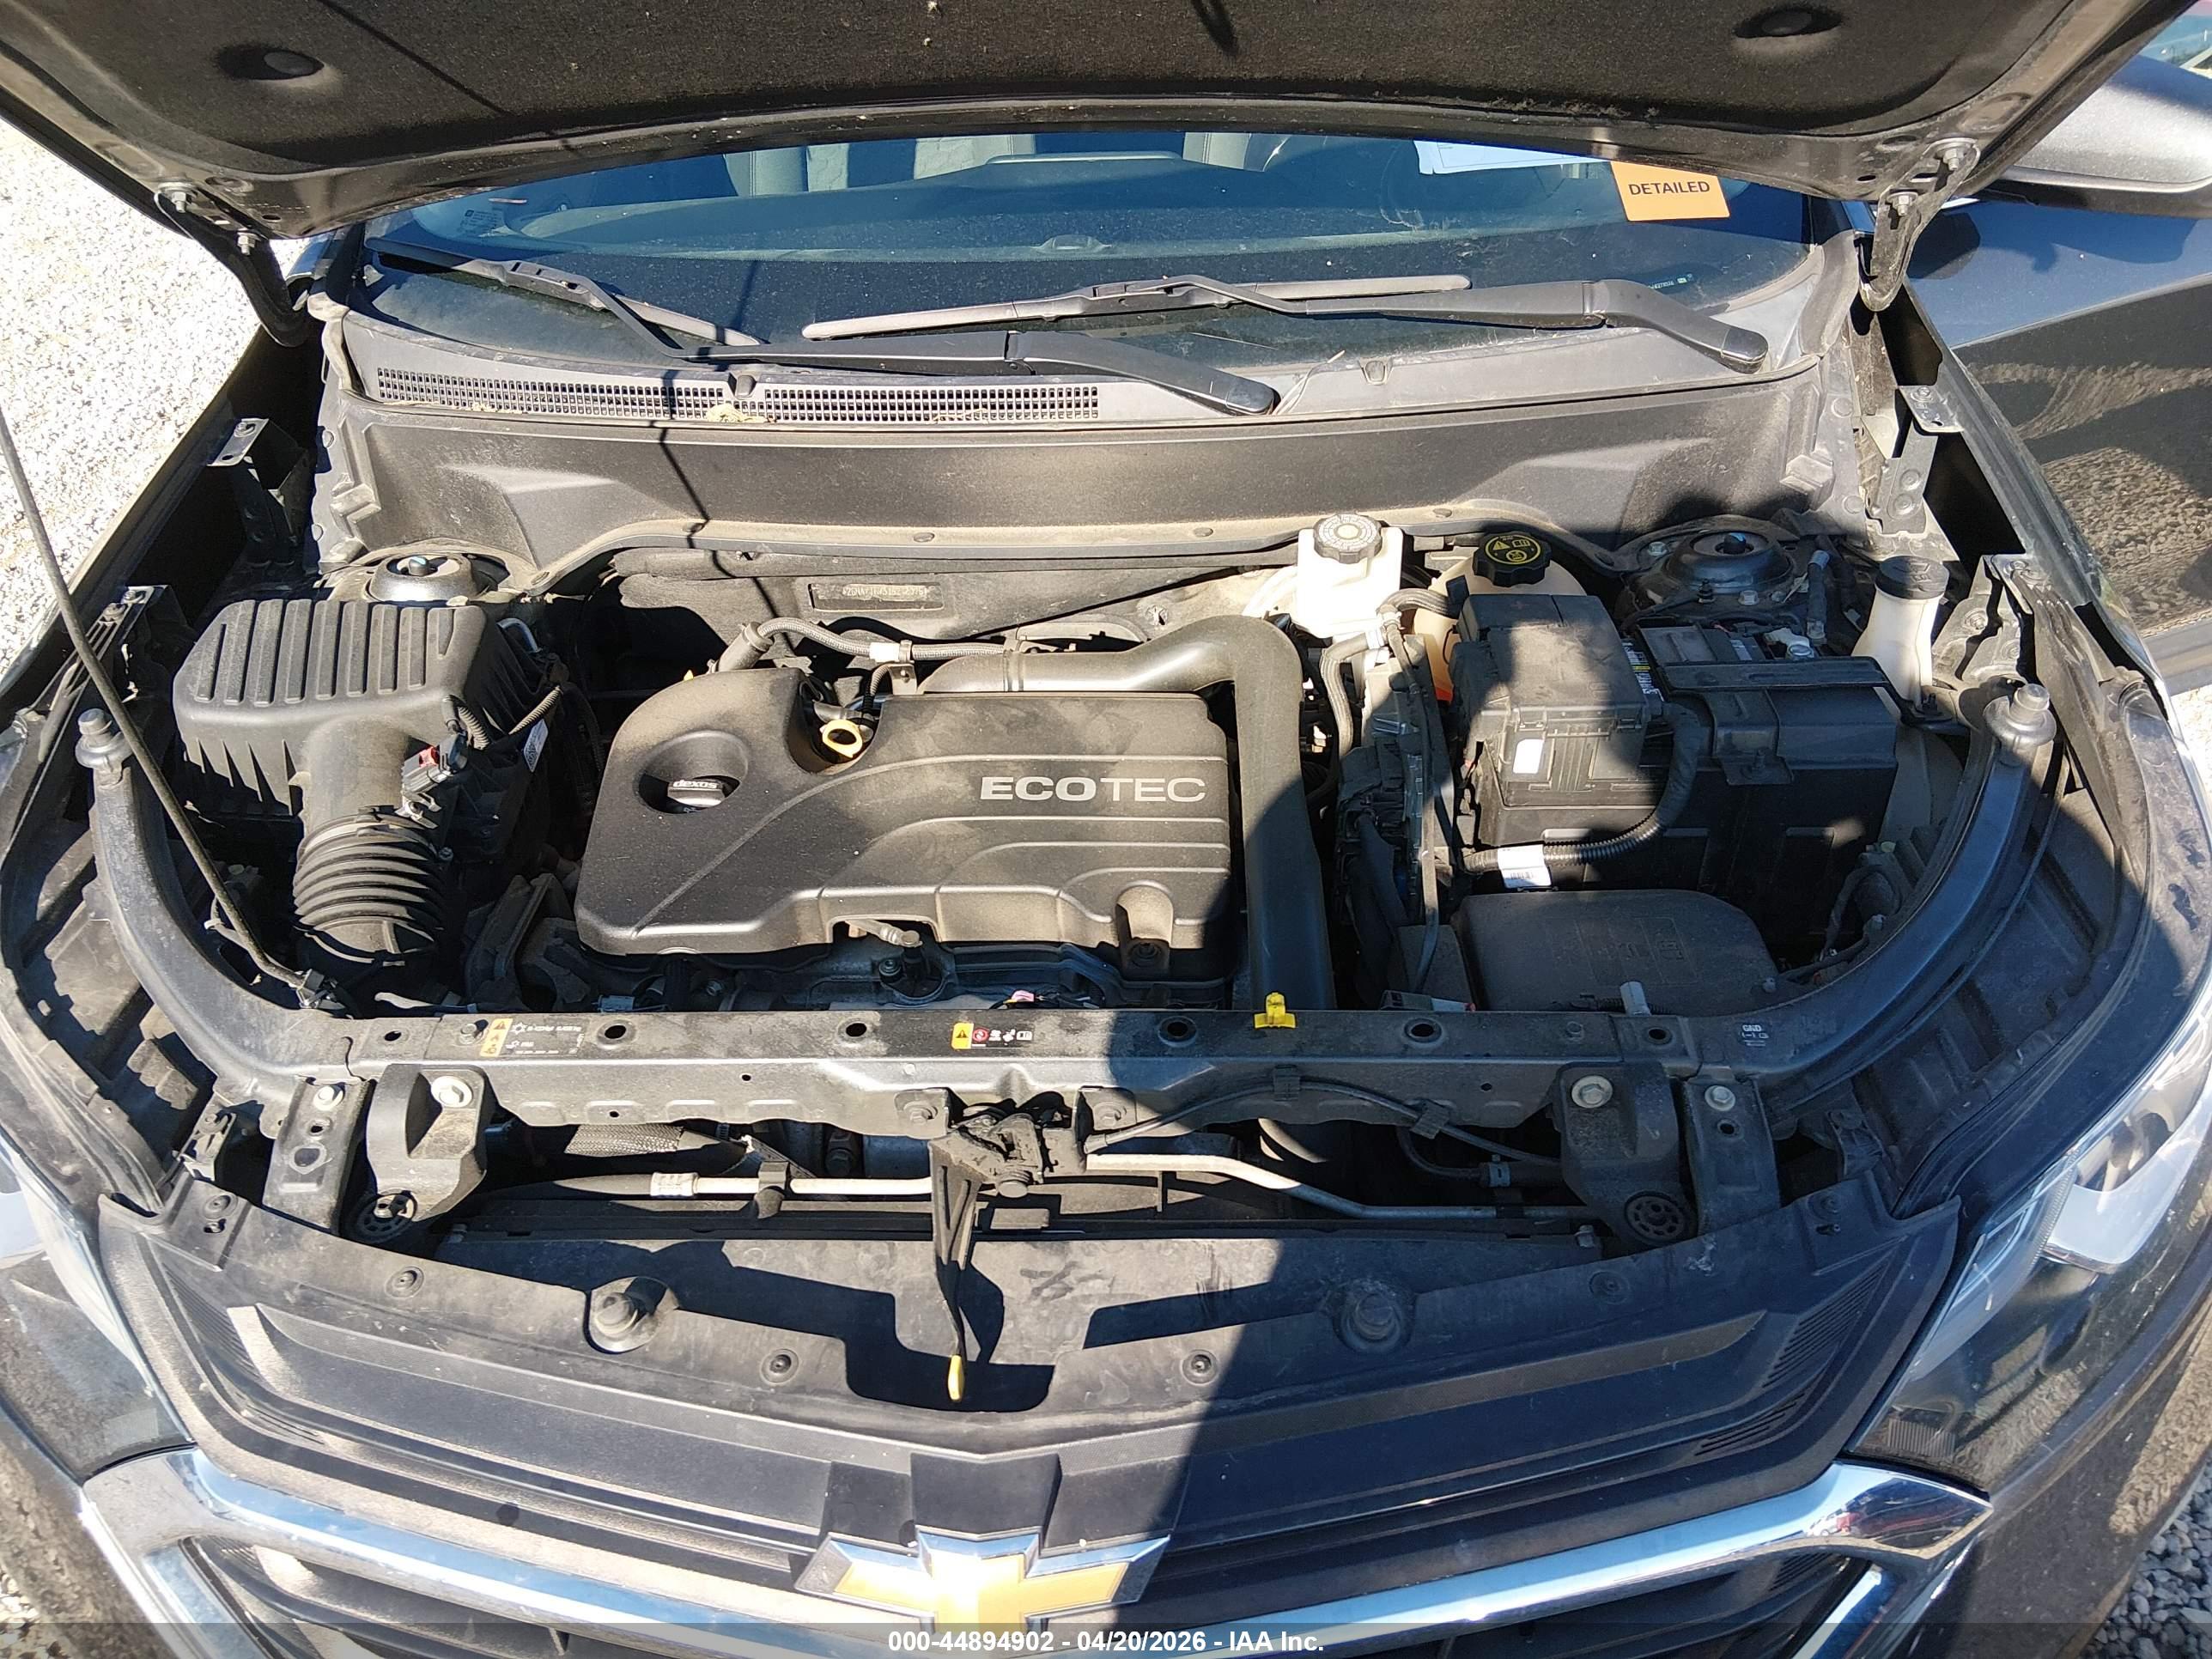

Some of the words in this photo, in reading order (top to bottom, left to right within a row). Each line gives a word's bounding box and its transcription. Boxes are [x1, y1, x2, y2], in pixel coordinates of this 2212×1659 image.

[1628, 181, 1711, 195] DETAILED
[672, 780, 719, 789] dexos
[980, 776, 1207, 803] ECOTEC
